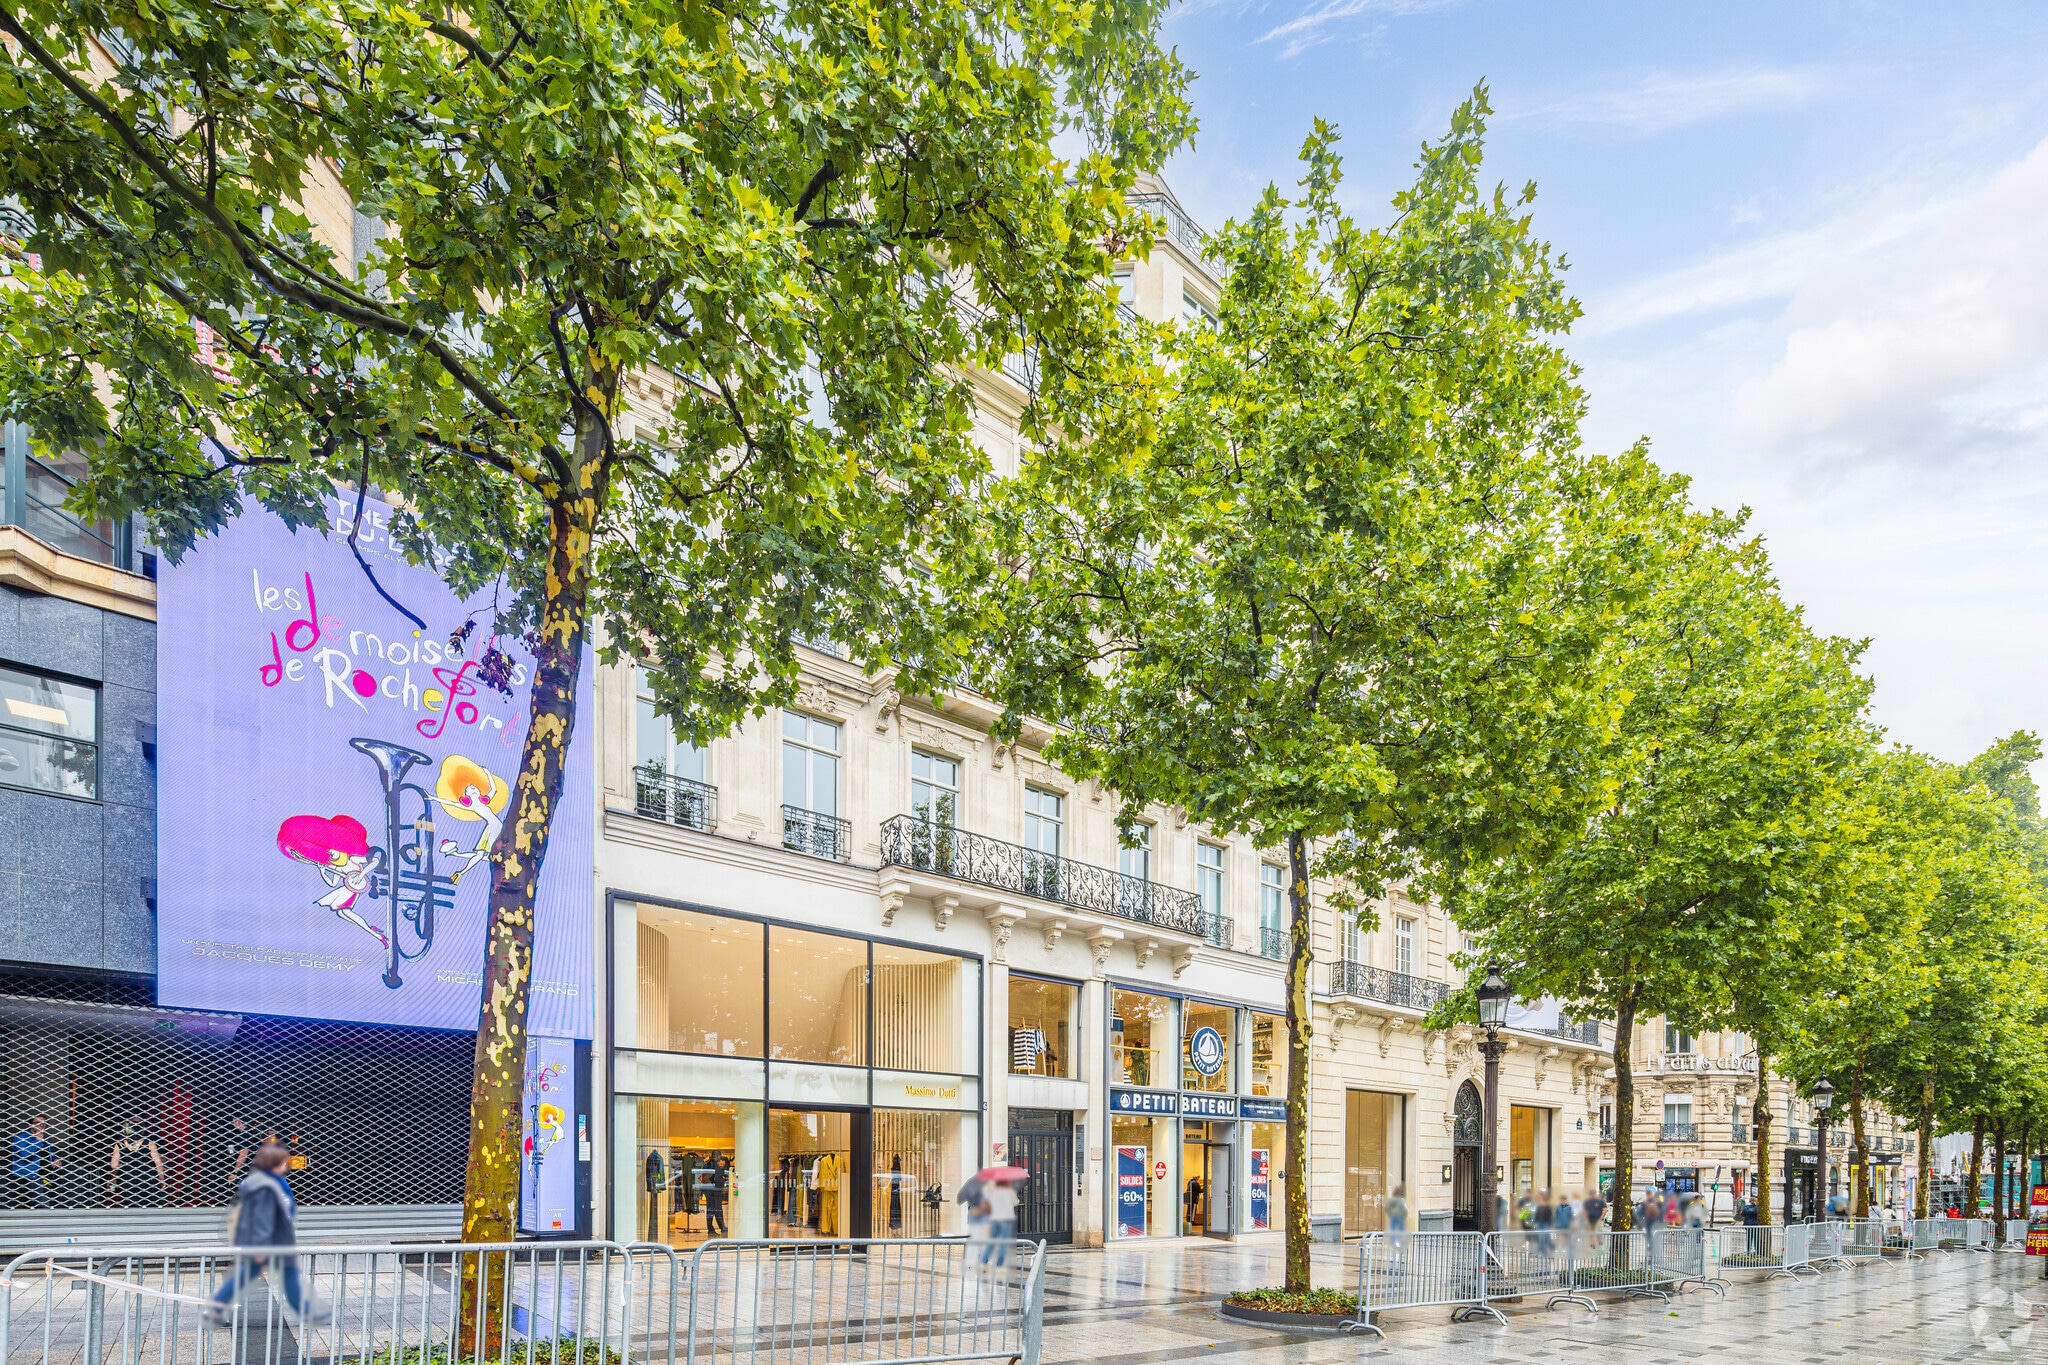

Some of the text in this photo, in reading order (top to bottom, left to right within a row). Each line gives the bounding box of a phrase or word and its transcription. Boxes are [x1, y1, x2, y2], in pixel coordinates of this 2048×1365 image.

[252, 567, 303, 614] les
[259, 631, 521, 749] de Rochefort
[191, 947, 354, 972] JACQUES DEMY
[437, 974, 484, 986] MICHE
[1193, 1051, 1224, 1073] PETIT BATEAU
[904, 1084, 956, 1099] Massimo Dutti
[1132, 1093, 1235, 1115] PETIT BATEAU
[1120, 1176, 1143, 1186] SOLDES
[1119, 1190, 1144, 1203] -60%
